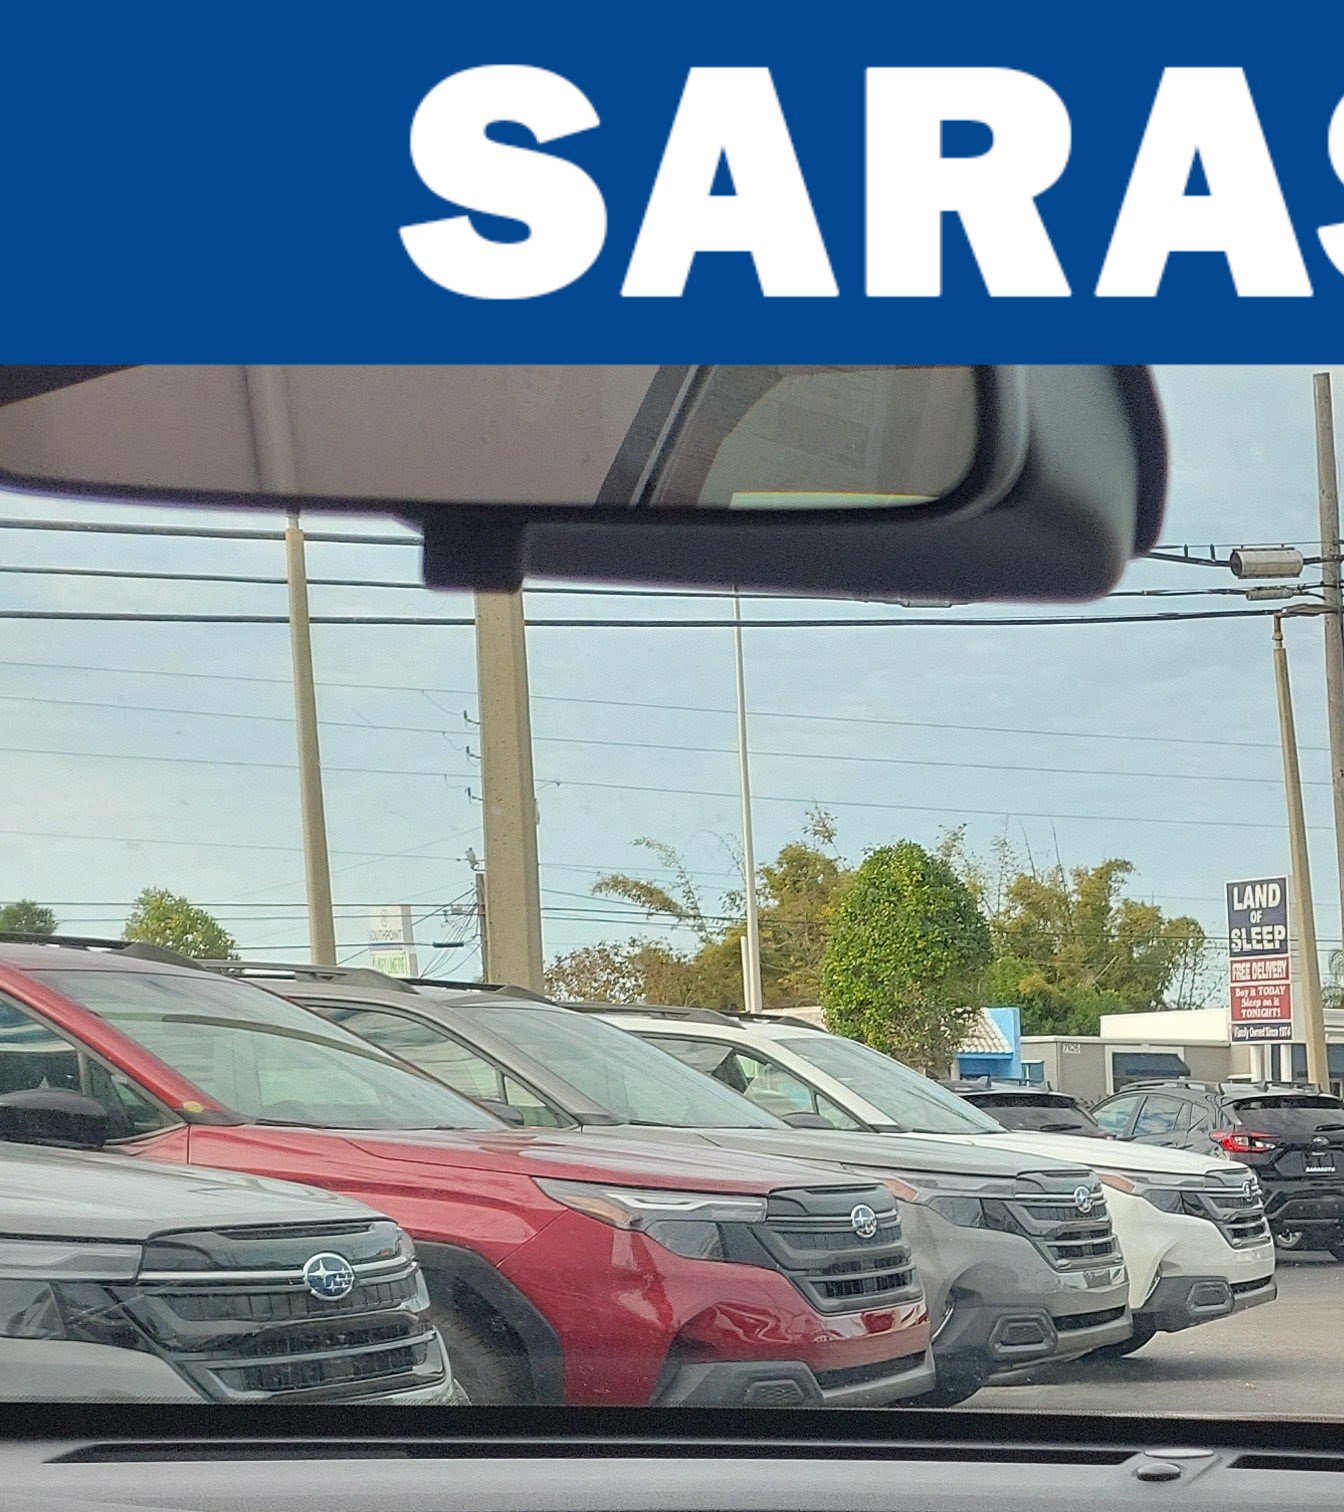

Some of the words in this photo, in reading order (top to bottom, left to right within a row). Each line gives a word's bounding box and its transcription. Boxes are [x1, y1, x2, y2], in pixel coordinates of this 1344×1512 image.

[1233, 883, 1281, 911] LAND
[1250, 910, 1263, 924] OF
[1231, 924, 1286, 953] SLEEP
[1232, 961, 1251, 981] FREE
[1251, 959, 1287, 979] DELIVERY
[1235, 988, 1249, 998] Buy
[1250, 987, 1256, 996] it
[1257, 986, 1286, 996] TODAY
[1241, 998, 1261, 1008] Sleep
[1240, 1007, 1281, 1018] TONIGHT!
[1233, 1026, 1249, 1039] Family
